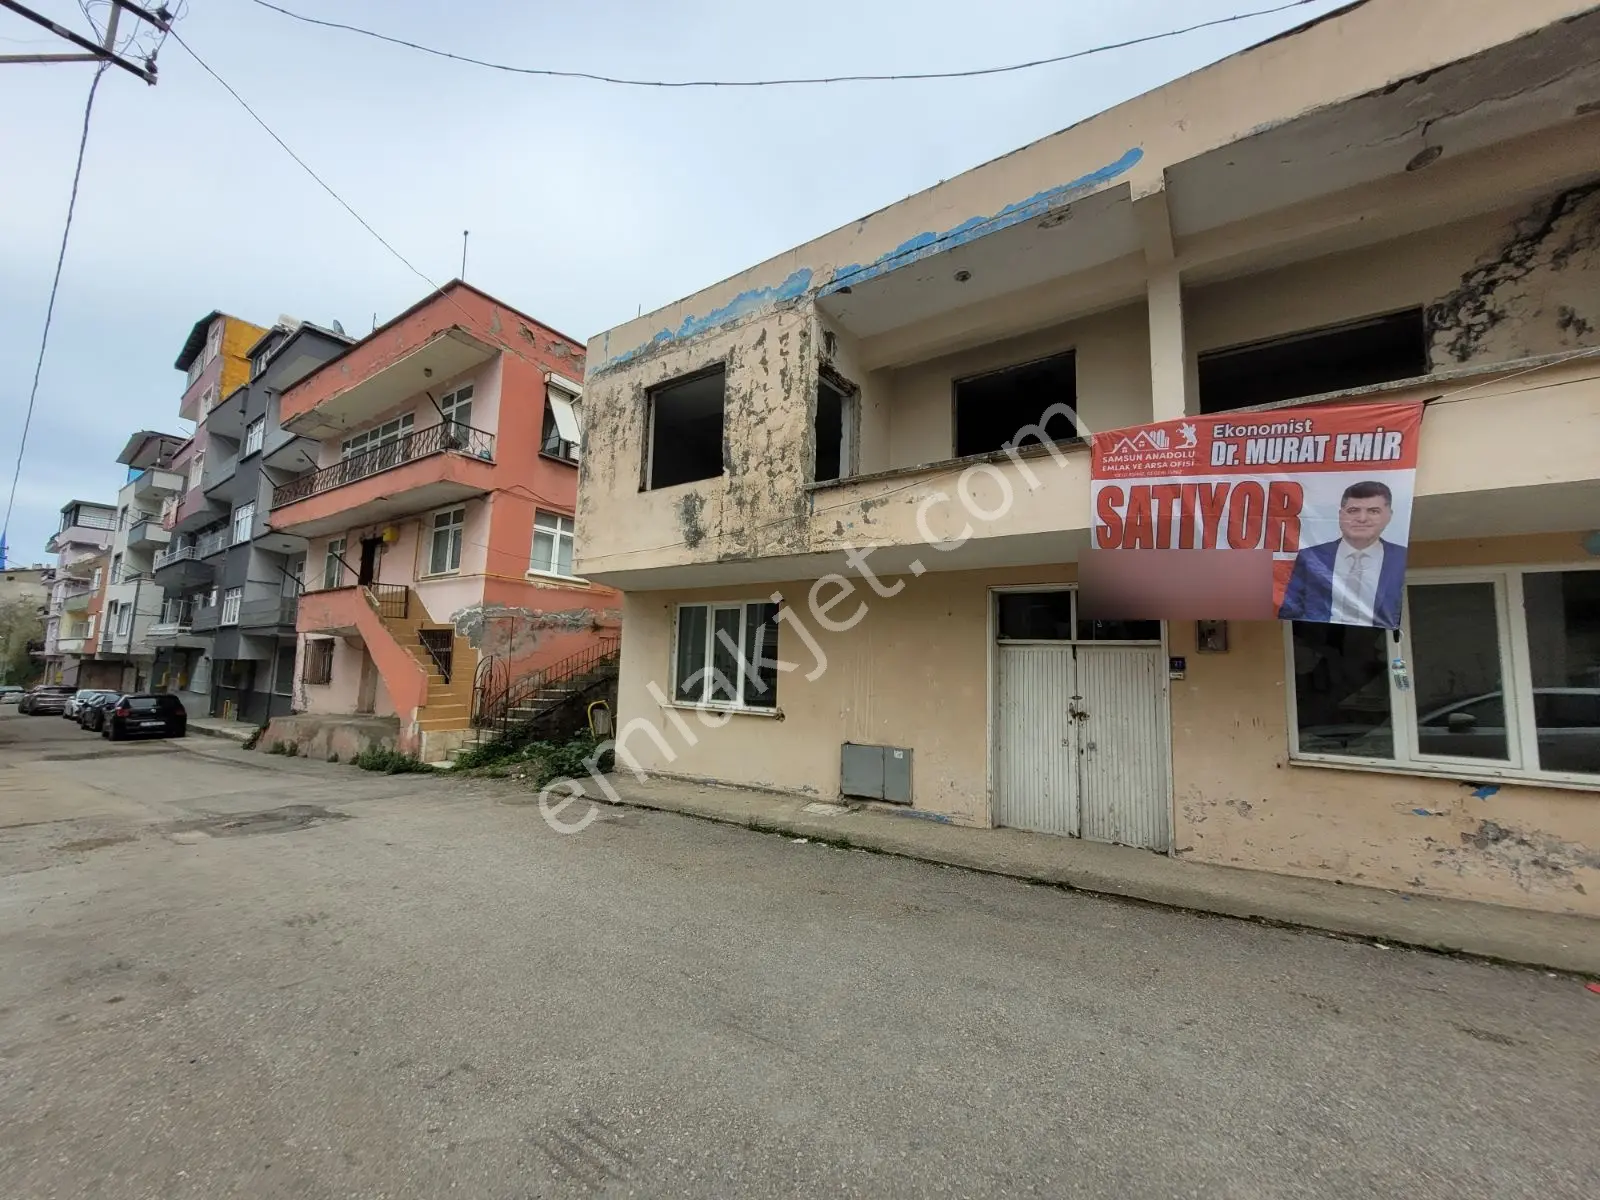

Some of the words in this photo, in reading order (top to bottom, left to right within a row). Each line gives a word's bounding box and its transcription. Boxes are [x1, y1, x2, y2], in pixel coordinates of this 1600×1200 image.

[1213, 418, 1313, 438] Ekonomist
[1102, 453, 1142, 463] SAMSUN
[1145, 450, 1195, 460] ANADOLU
[1210, 440, 1239, 466] Dr.
[1245, 435, 1330, 465] MURAT
[1333, 427, 1403, 463] EMİR
[1102, 464, 1130, 472] EMLAK
[1132, 462, 1142, 470] VE
[1144, 461, 1168, 469] ARSA
[1096, 480, 1304, 553] SATIYOR
